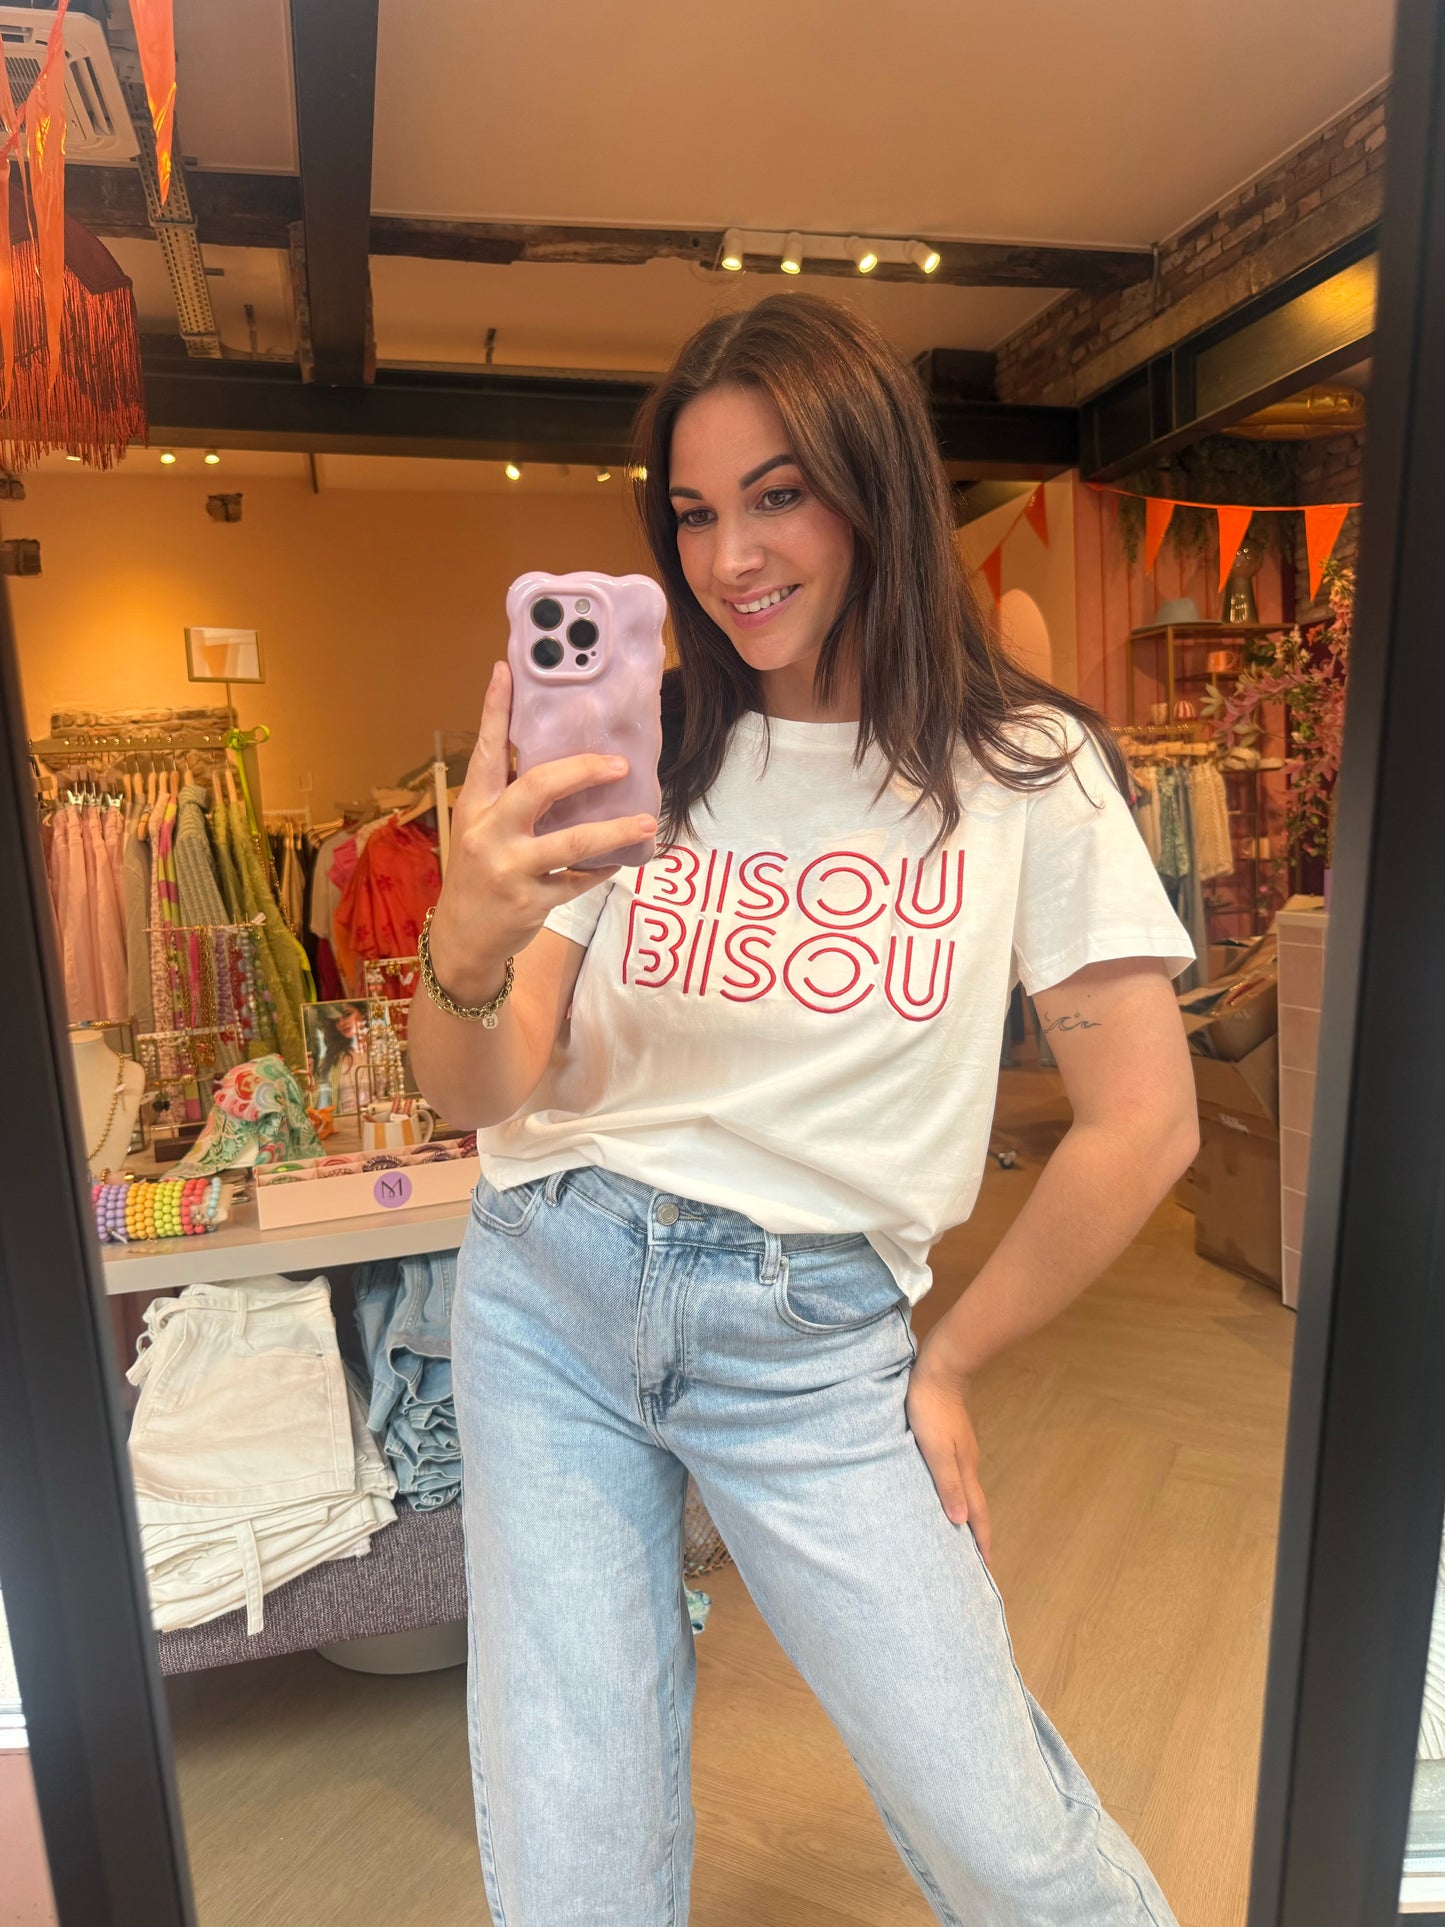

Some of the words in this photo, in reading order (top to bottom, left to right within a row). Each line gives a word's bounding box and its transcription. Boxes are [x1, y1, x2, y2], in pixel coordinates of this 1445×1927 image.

[634, 843, 965, 929] BISOU
[622, 899, 955, 1022] BISOU
[381, 1177, 403, 1199] M
